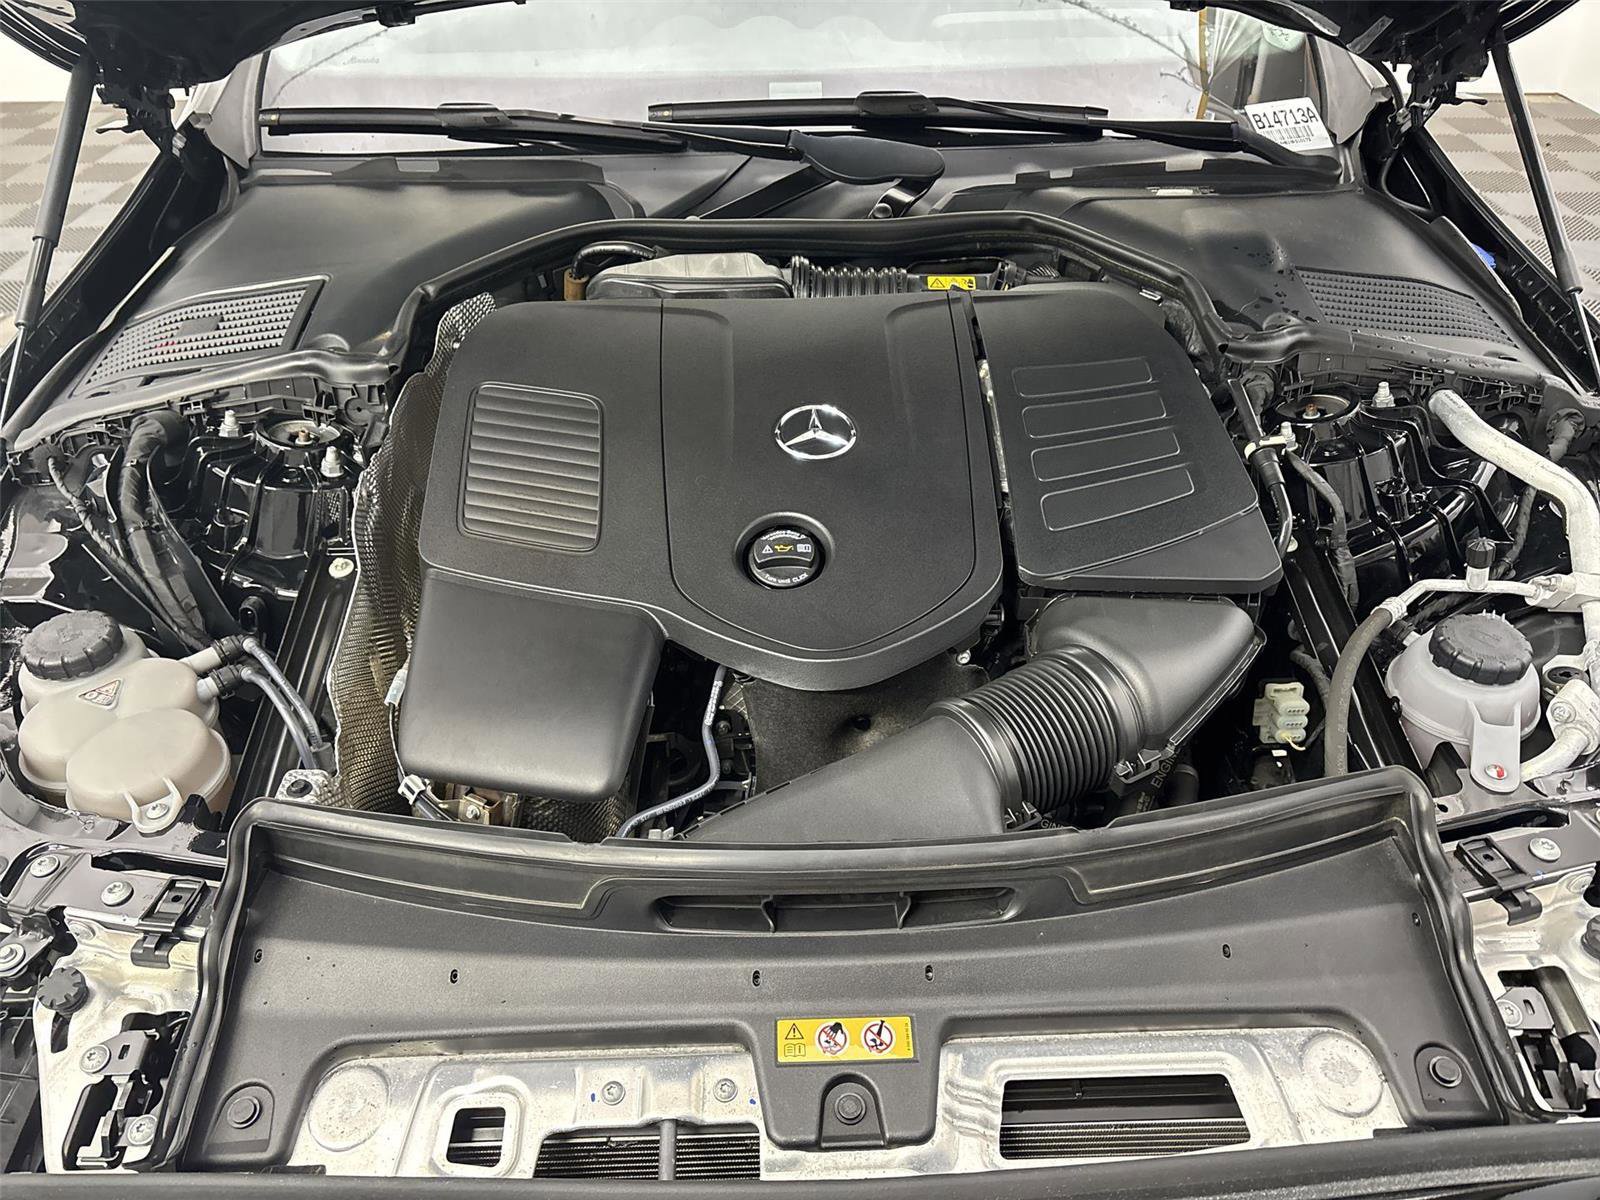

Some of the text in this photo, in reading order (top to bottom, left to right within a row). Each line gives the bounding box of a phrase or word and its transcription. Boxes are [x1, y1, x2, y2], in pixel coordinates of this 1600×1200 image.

[1252, 107, 1319, 130] B14713A
[764, 573, 777, 583] Turn
[792, 573, 809, 583] CLICK
